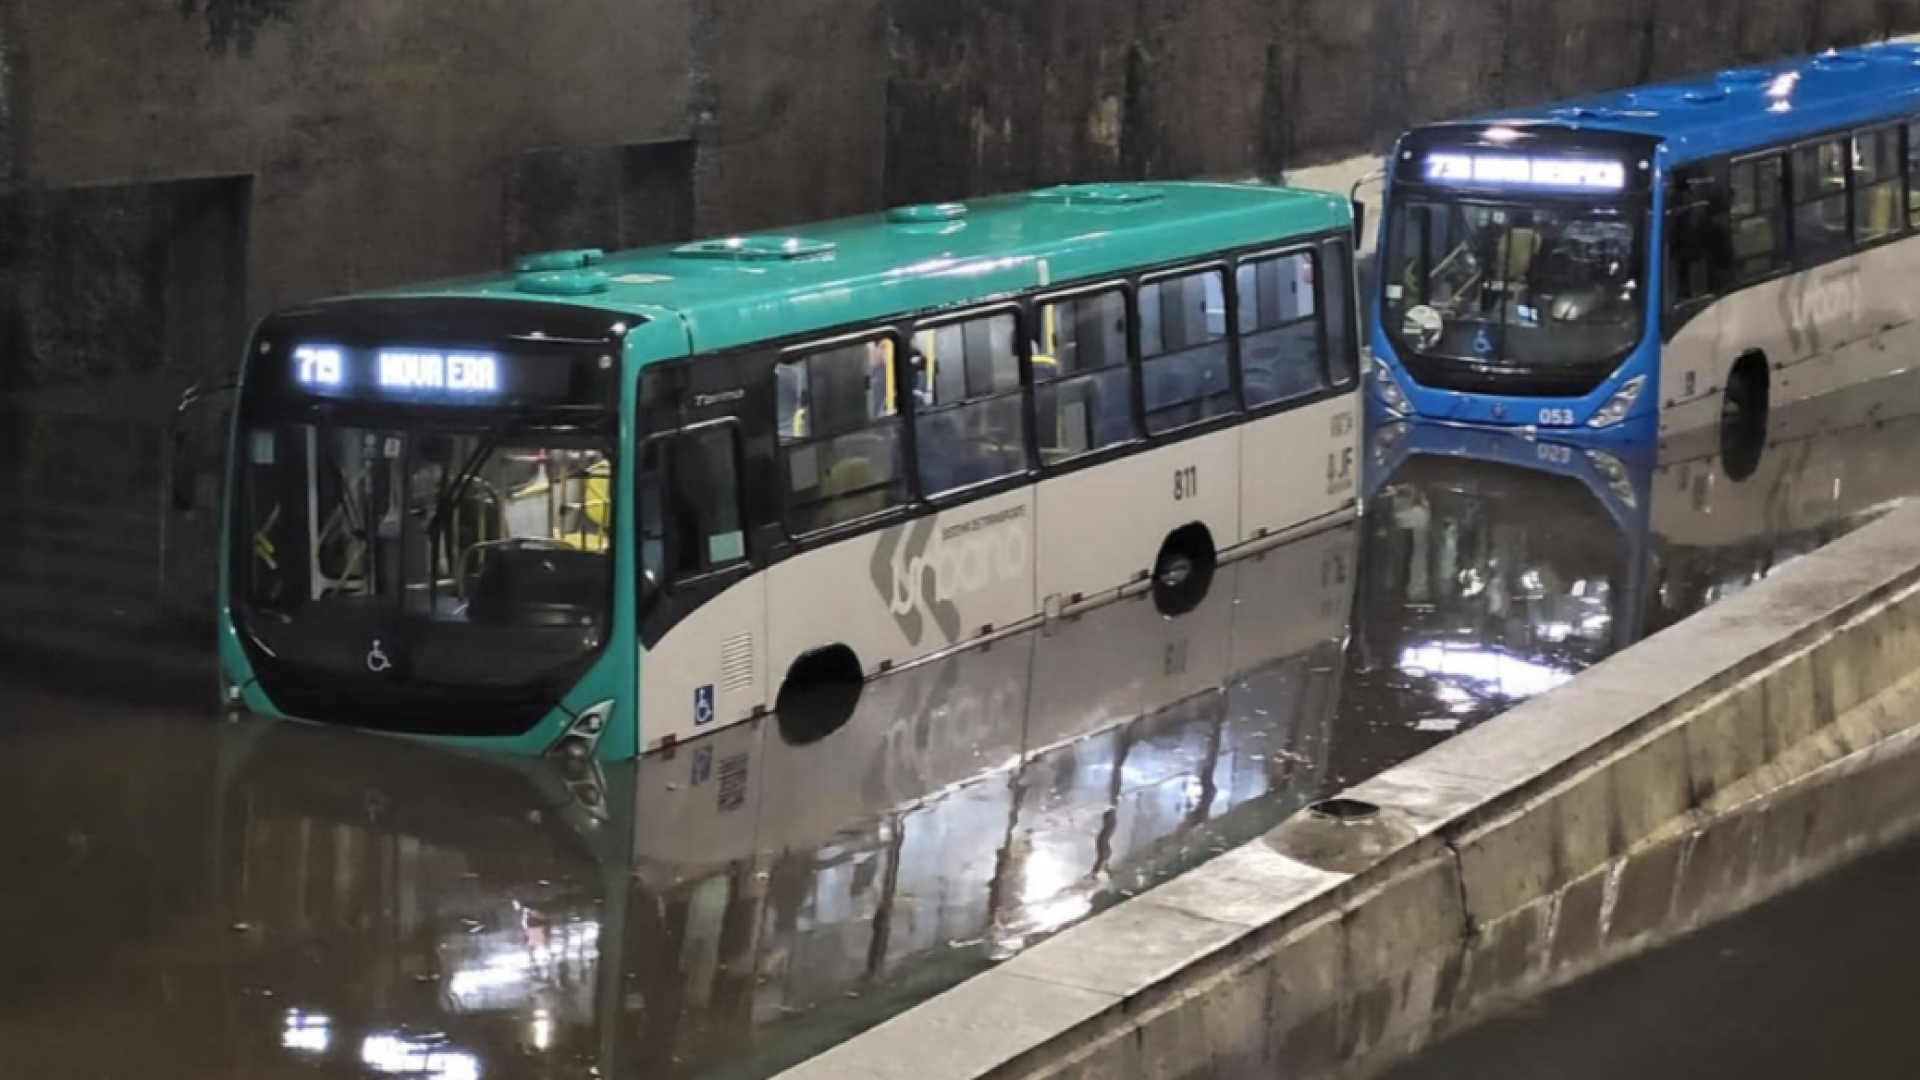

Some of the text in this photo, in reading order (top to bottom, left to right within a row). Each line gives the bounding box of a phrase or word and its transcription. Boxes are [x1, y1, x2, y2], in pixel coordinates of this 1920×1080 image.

[379, 352, 443, 388] NOVA
[446, 354, 496, 391] ERA
[1538, 408, 1574, 425] 053
[1173, 465, 1198, 501] 811
